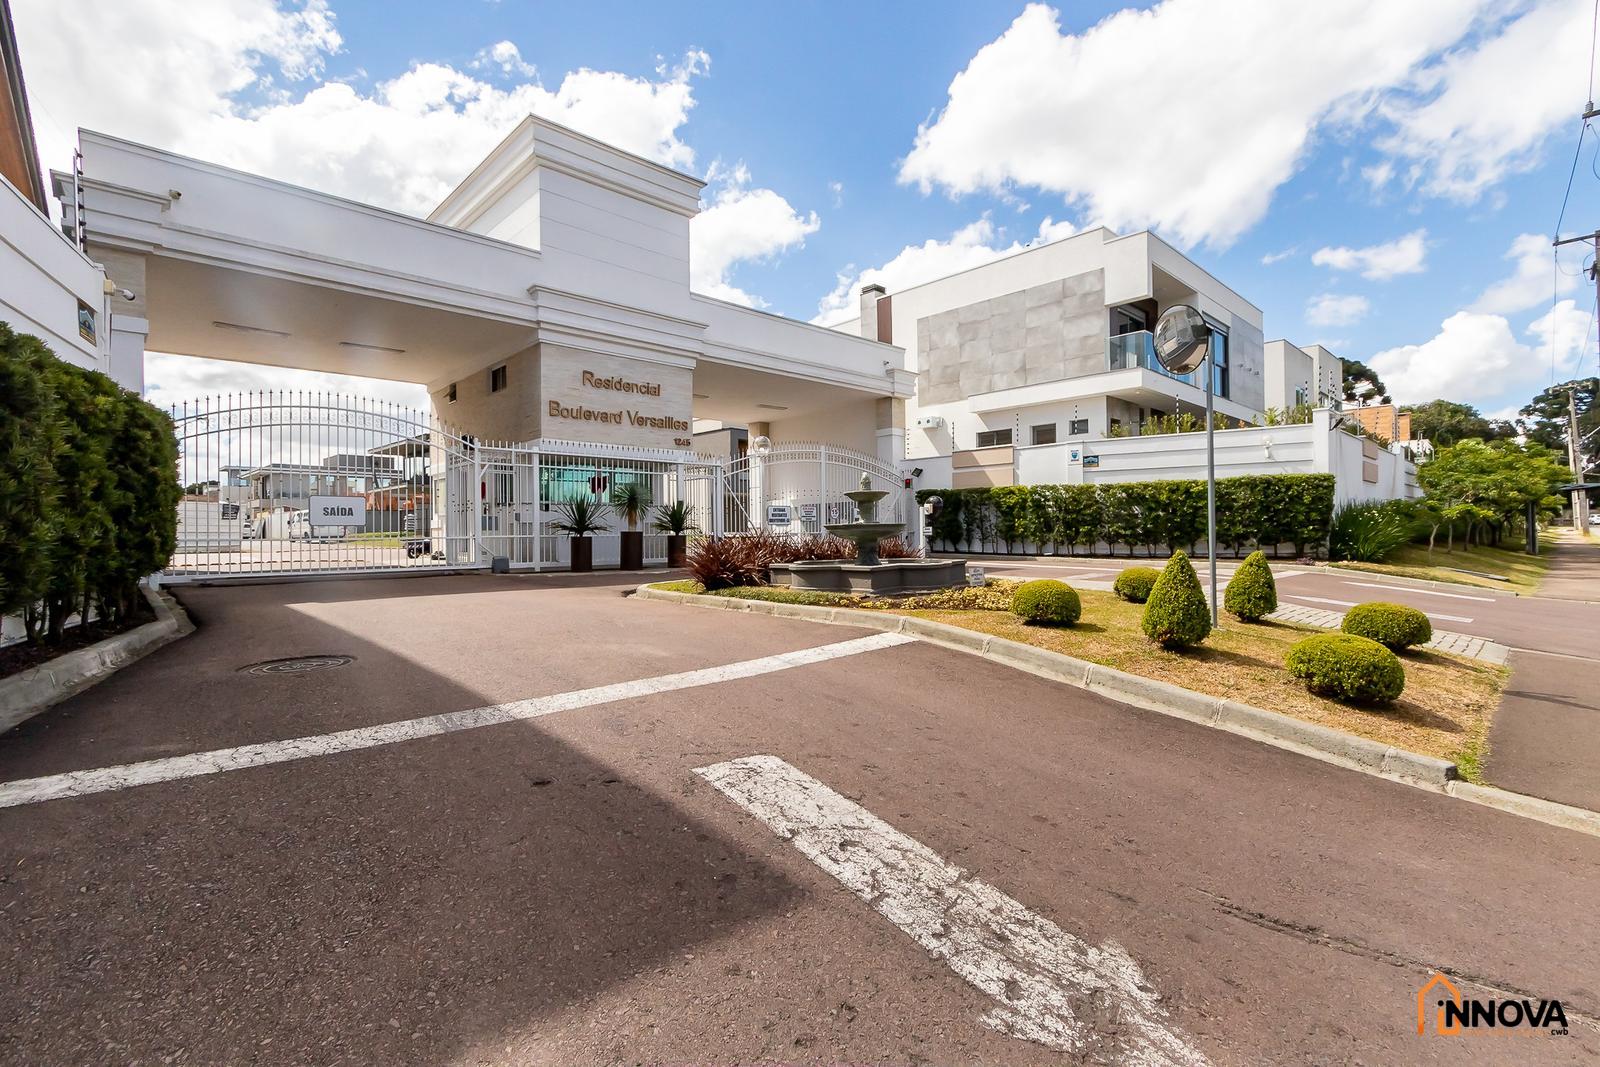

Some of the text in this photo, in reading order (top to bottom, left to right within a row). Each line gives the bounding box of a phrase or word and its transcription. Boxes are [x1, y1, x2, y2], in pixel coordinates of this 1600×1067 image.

[582, 370, 661, 397] Residencial
[549, 400, 689, 432] Boulevard Versailles
[322, 505, 354, 517] SAÍDA
